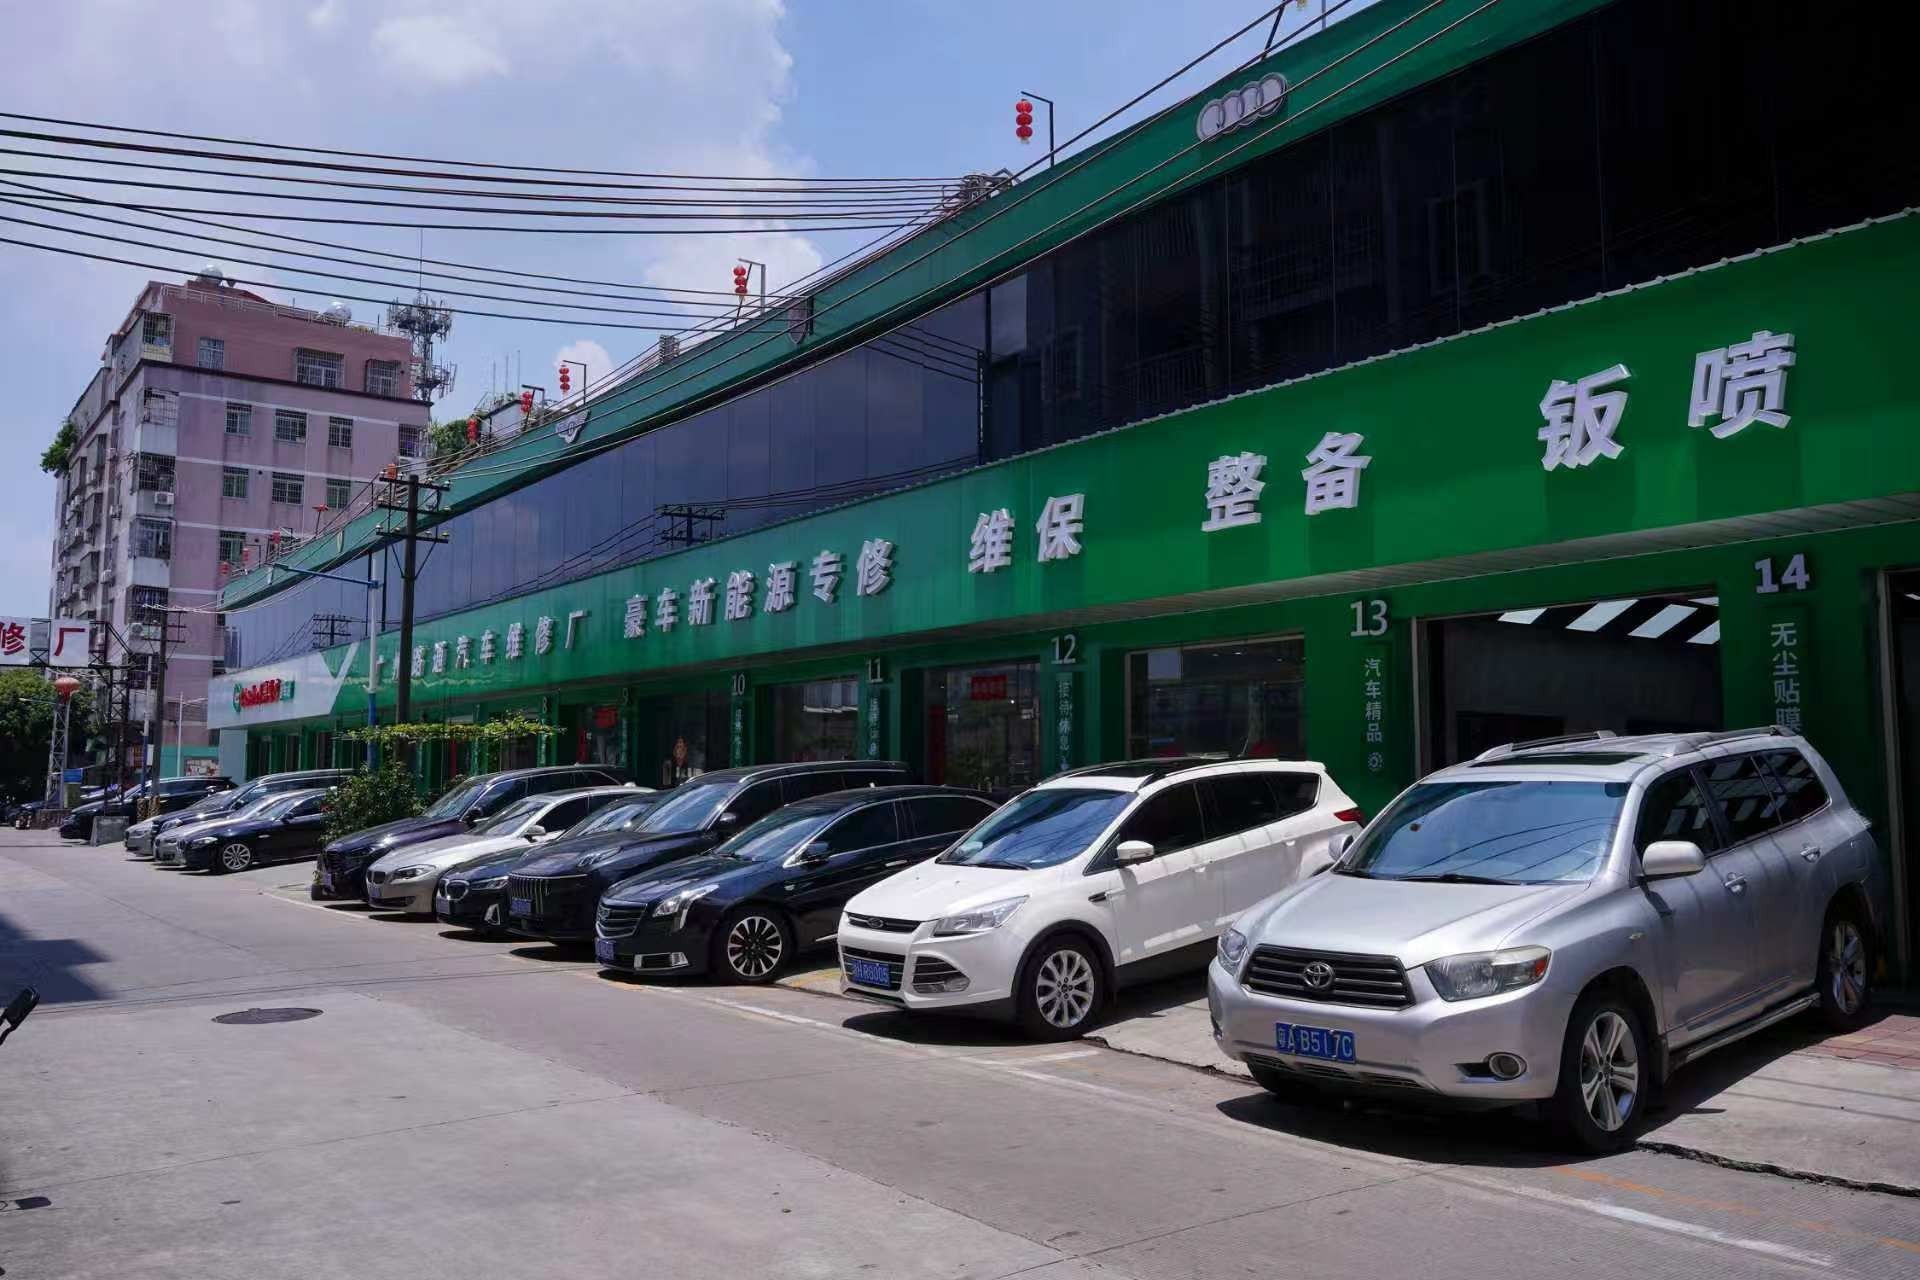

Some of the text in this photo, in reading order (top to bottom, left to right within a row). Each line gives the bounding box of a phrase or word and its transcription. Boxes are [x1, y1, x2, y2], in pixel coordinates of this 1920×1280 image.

[623, 538, 894, 639] 豪车新能源专修
[969, 494, 1086, 573] 维保
[1201, 432, 1372, 532] 整备
[1538, 330, 1797, 471] 钣喷
[1754, 553, 1810, 594] 14
[1350, 599, 1388, 637] 13
[1050, 634, 1076, 664] 12
[731, 673, 746, 696] 10
[865, 658, 883, 684] 11
[1770, 622, 1802, 734] 无尘贴膜
[1364, 658, 1383, 743] 汽车精品
